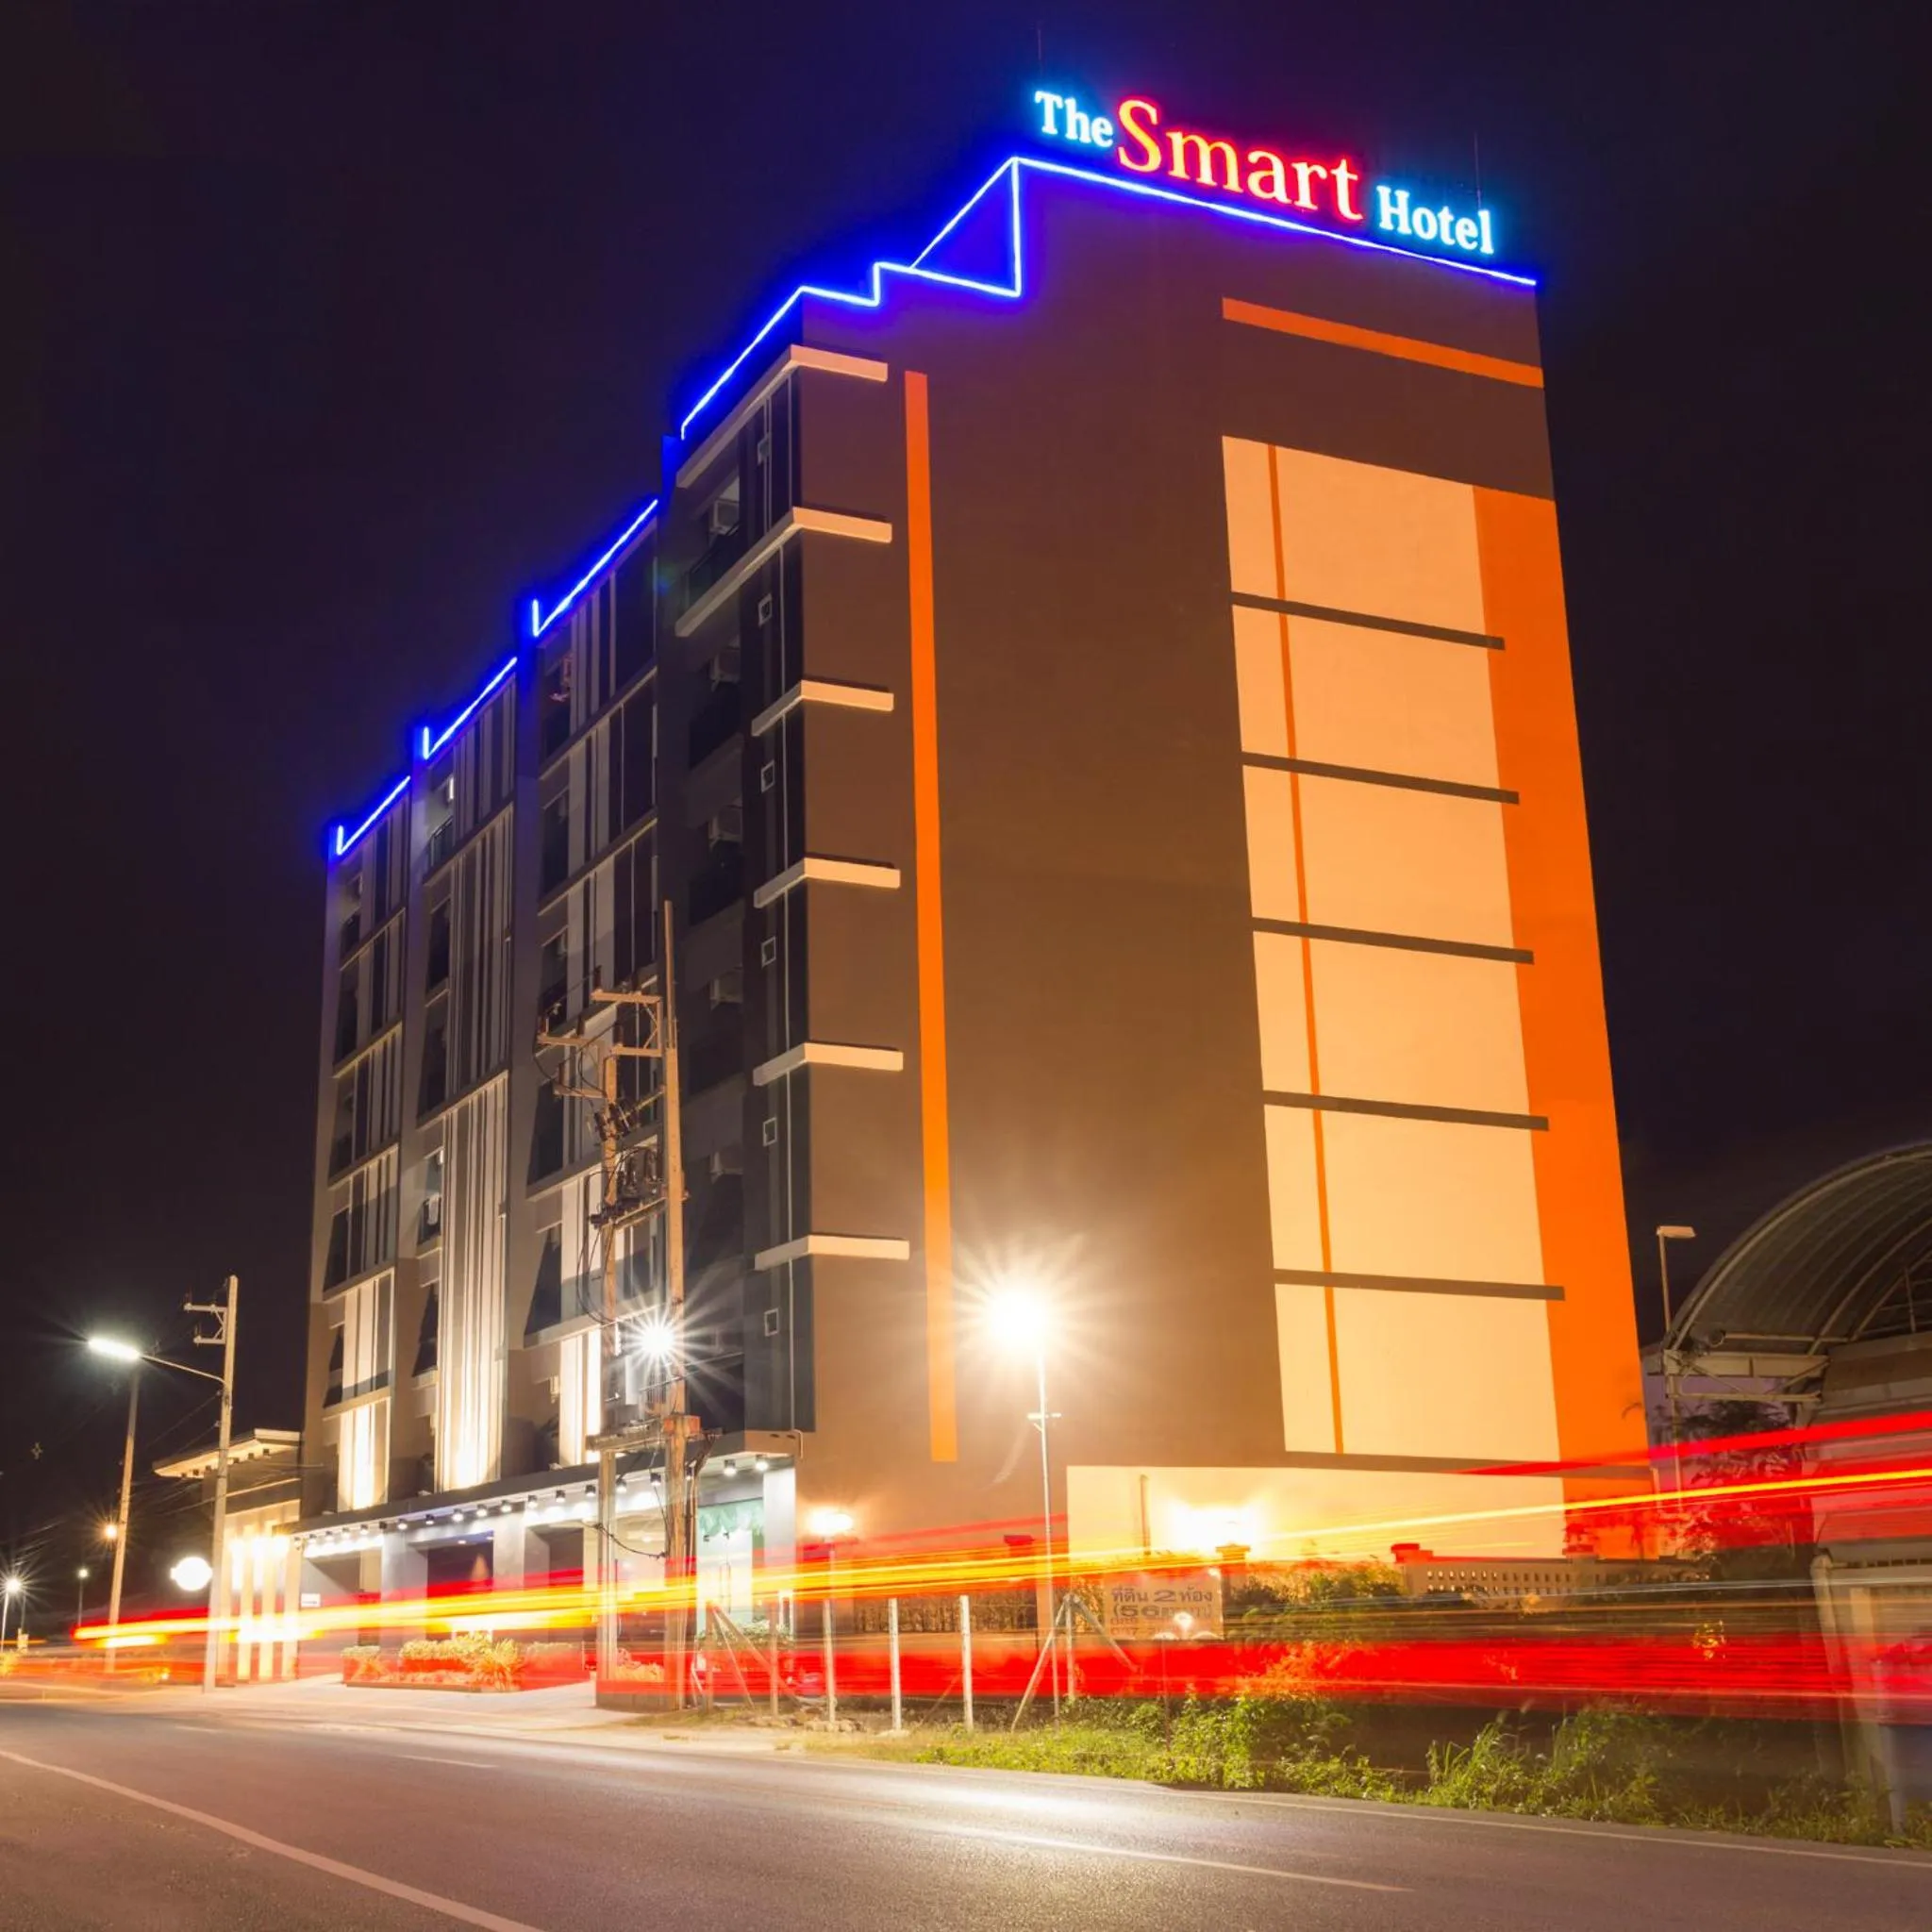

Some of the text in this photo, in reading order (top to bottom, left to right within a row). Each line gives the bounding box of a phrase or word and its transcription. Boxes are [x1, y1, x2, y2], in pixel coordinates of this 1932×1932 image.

[1034, 91, 1494, 255] The Smart Hotel
[1154, 1589, 1176, 1602] 2
